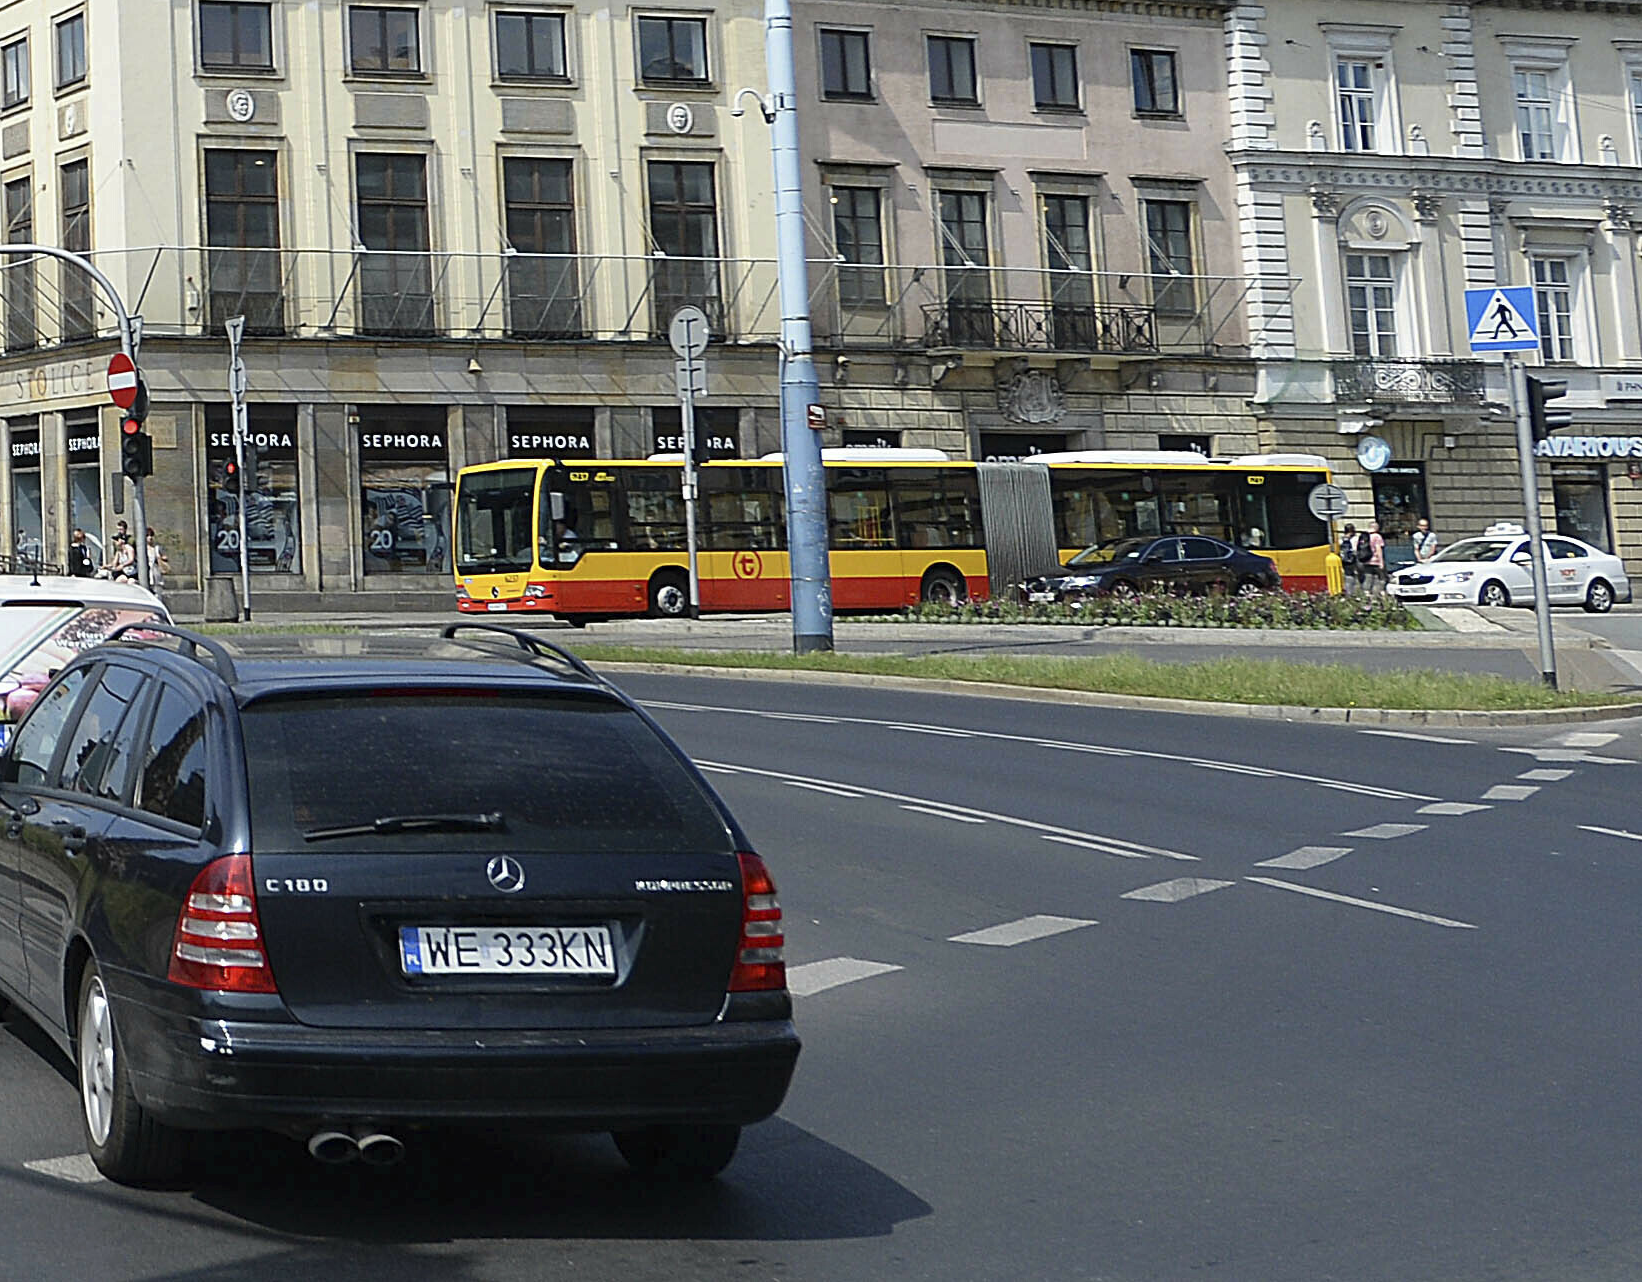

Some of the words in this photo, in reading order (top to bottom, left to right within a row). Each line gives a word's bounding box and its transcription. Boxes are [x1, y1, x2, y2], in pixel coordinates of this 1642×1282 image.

[211, 433, 292, 447] SEHORA
[363, 434, 442, 448] SEPHORA
[511, 435, 590, 449] SEPHORA
[657, 436, 735, 449] SEPRA
[1532, 436, 1642, 457] AVARIOUS
[12, 442, 40, 457] SEPHOR
[217, 530, 239, 550] 20
[370, 530, 393, 550] 20
[266, 878, 279, 892] C
[425, 931, 480, 967] WE
[493, 931, 608, 968] 333KN
